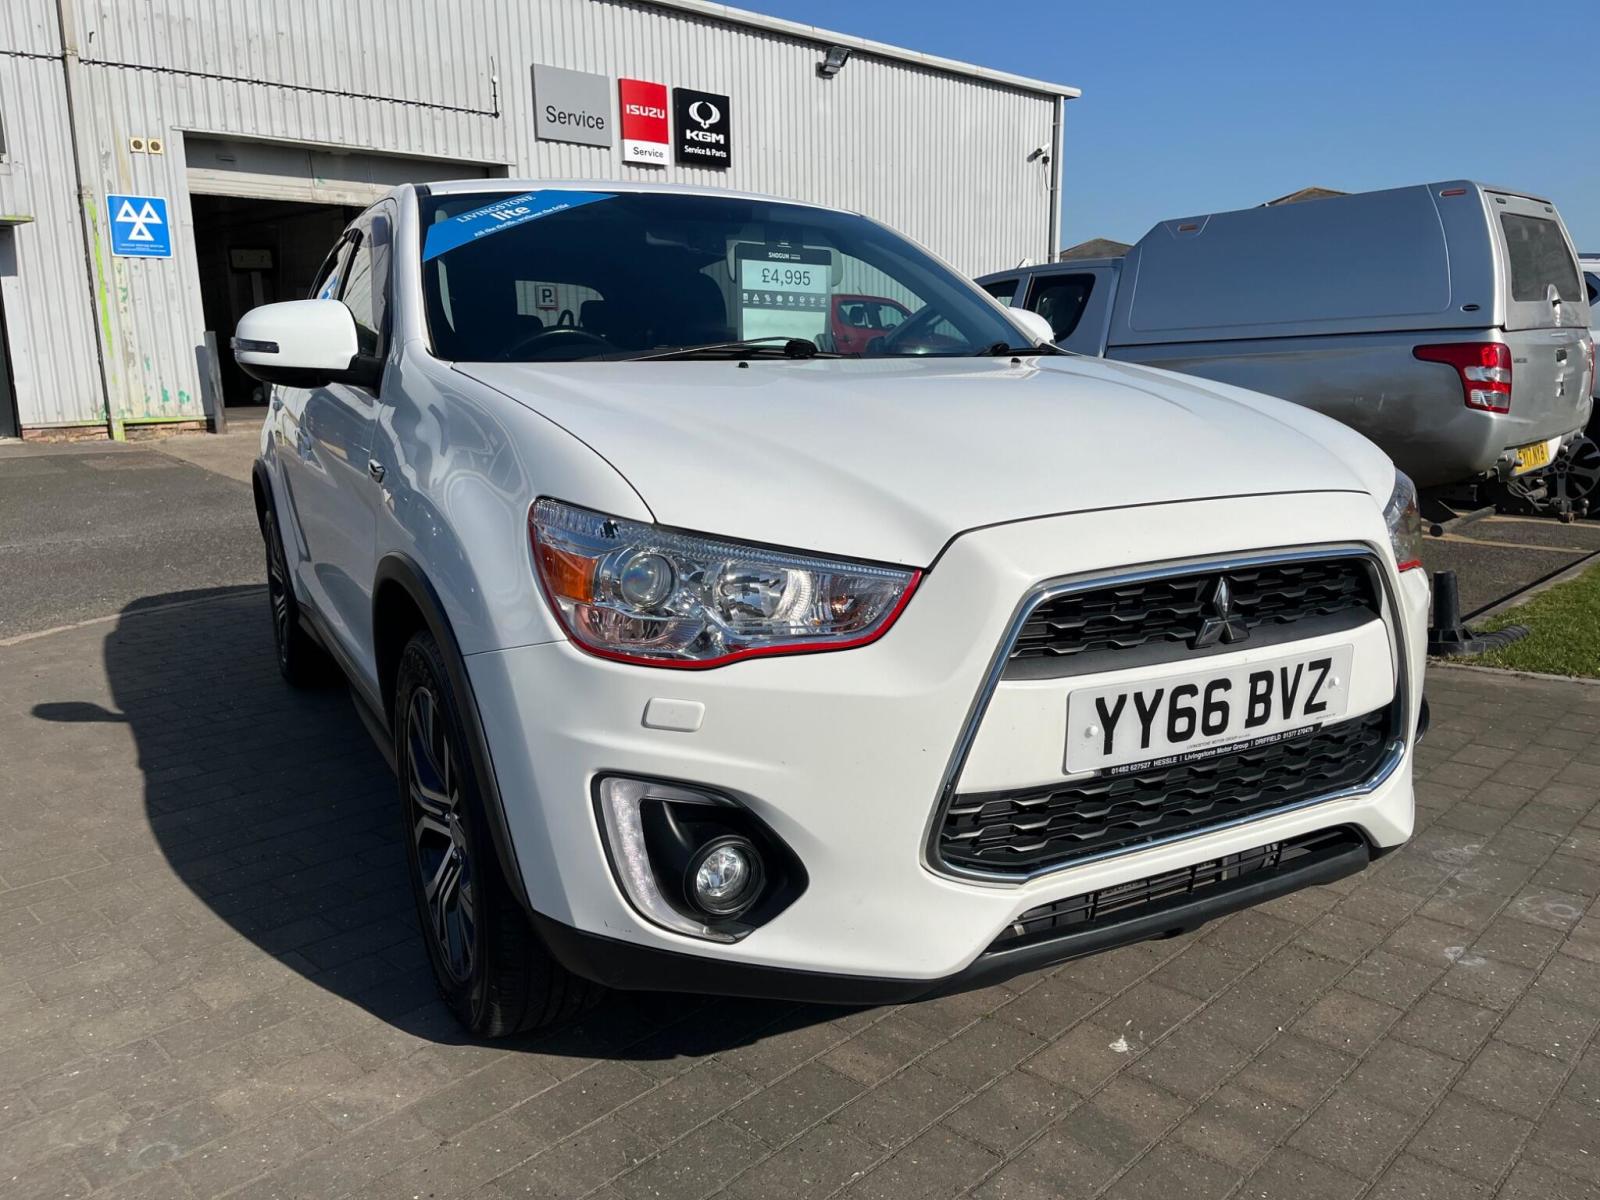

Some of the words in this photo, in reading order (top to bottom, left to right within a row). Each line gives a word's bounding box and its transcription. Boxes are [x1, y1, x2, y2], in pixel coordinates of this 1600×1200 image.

[546, 105, 605, 130] Service
[626, 104, 665, 119] ISUZU
[686, 129, 725, 144] KGM
[633, 147, 664, 158] Service
[684, 145, 706, 155] Service
[706, 148, 711, 156] &
[711, 149, 727, 158] Parts
[456, 195, 536, 223] LIVINGSTONE
[490, 206, 531, 221] lite
[761, 268, 811, 286] £4,995
[1095, 678, 1232, 755] YY66
[1245, 657, 1332, 729] BVZ
[1153, 756, 1178, 766] HESSLE
[1184, 750, 1216, 760] Livingstone
[1216, 746, 1232, 754] Motor
[1254, 734, 1281, 746] DRIFFIELD
